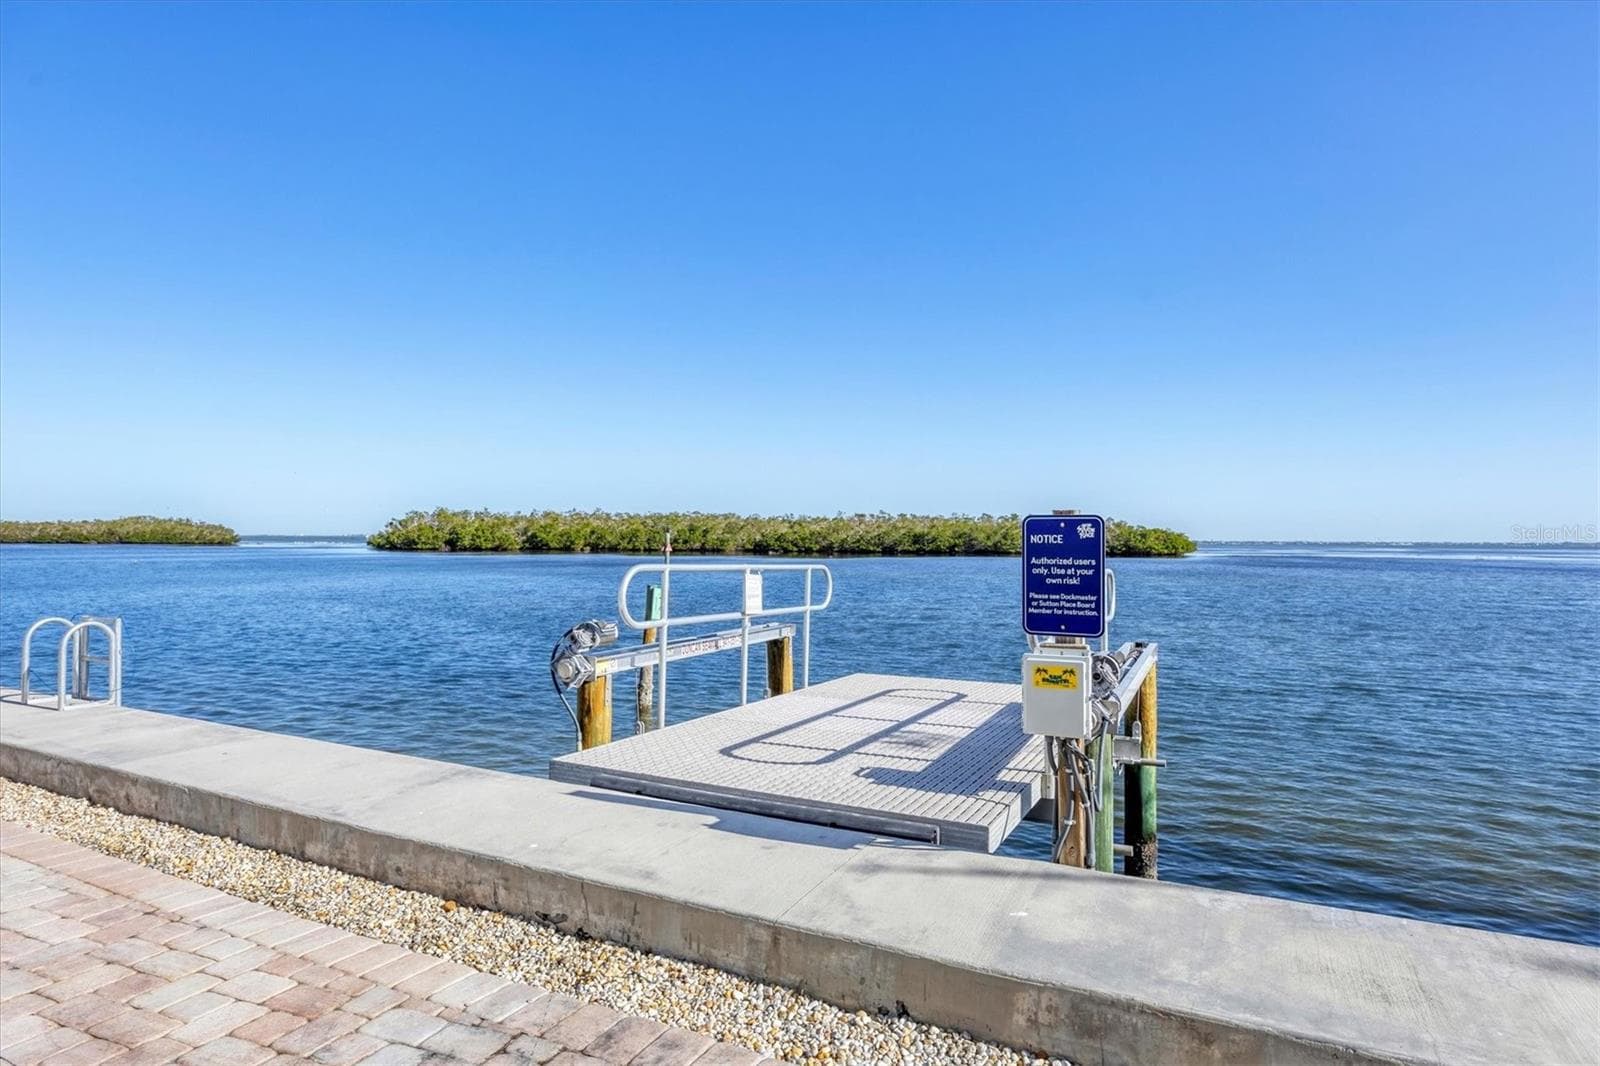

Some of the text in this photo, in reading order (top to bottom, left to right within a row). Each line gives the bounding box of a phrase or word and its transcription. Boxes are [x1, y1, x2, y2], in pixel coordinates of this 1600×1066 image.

[1030, 534, 1063, 544] NOTICE
[1030, 556, 1096, 566] Authorized users
[1032, 566, 1095, 577] only. Use at your
[1063, 576, 1080, 585] risk!
[1060, 593, 1098, 601] Dockmaster
